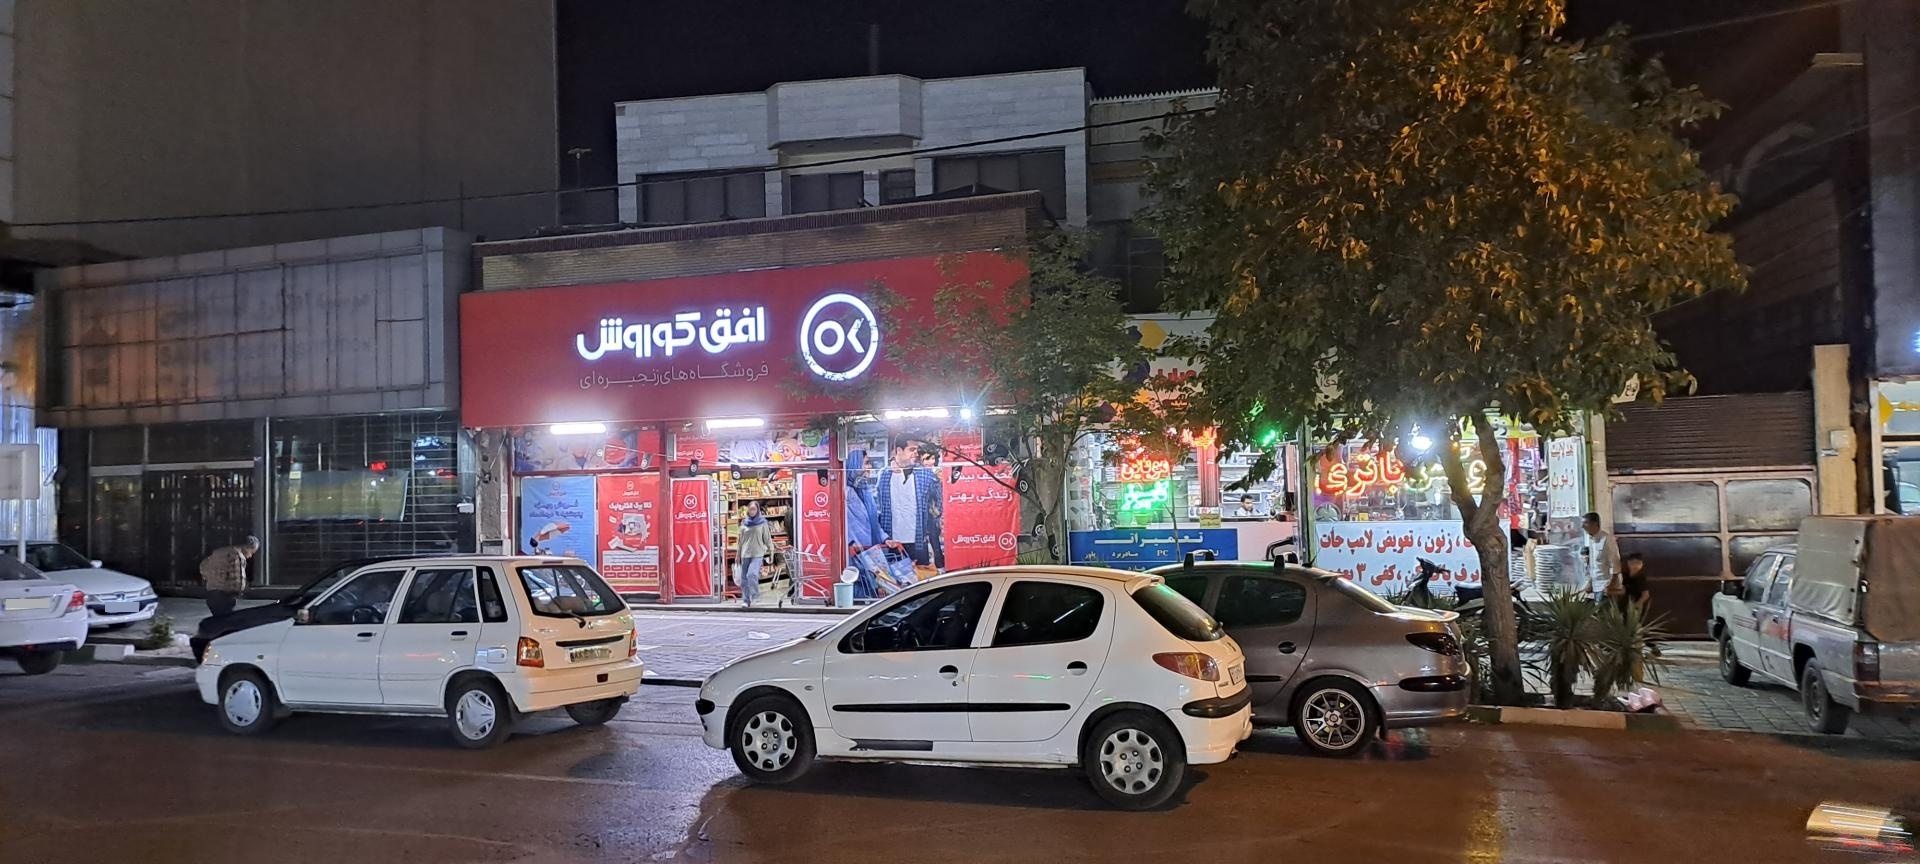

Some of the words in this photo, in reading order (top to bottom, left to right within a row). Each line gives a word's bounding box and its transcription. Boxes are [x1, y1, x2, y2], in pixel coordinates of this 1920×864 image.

[576, 311, 701, 361] کوروش
[699, 306, 765, 354] افق
[597, 367, 660, 390] زنجیره
[689, 360, 769, 383] فروشگاه
[976, 469, 1013, 482] تخیف
[948, 490, 975, 503] بهتر
[975, 487, 1013, 502] زندگی
[951, 534, 981, 545] کوروش
[980, 534, 996, 544] افق
[1094, 532, 1204, 548] تعمیرات
[1346, 528, 1373, 555] لامپ
[1376, 530, 1414, 554] تعویض
[1156, 549, 1169, 557] PC
[1355, 562, 1367, 582] ۳
